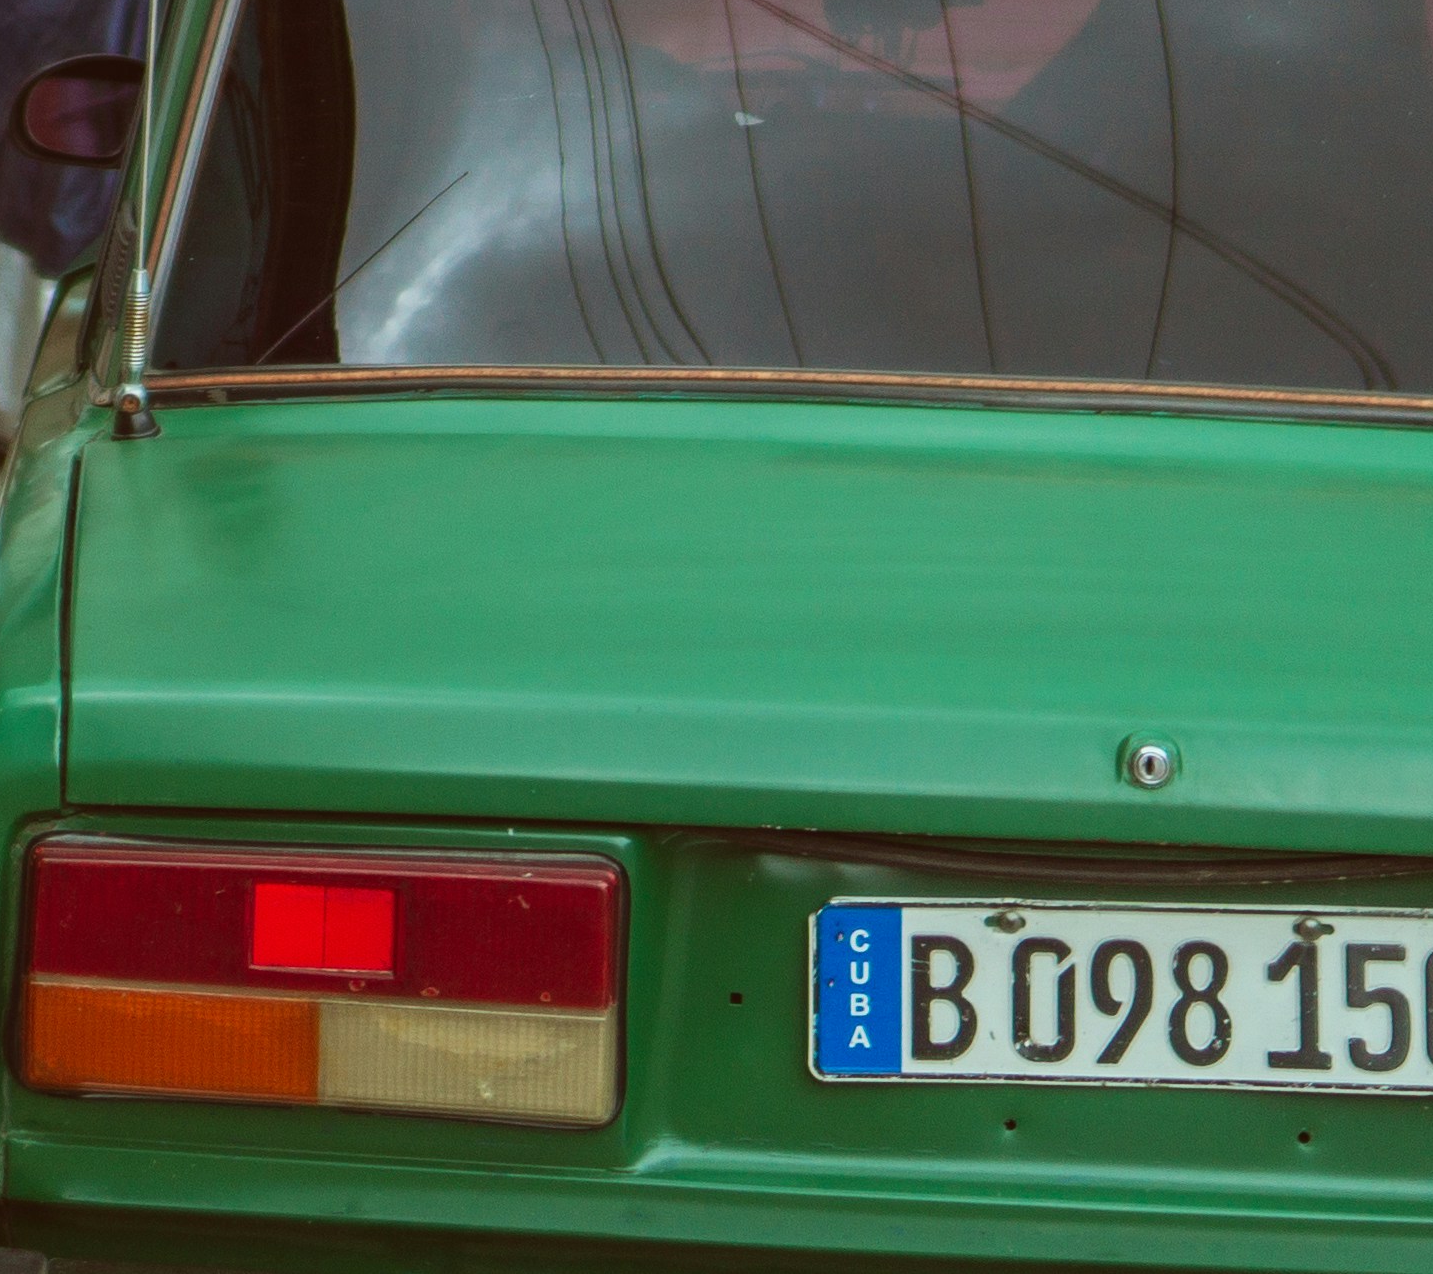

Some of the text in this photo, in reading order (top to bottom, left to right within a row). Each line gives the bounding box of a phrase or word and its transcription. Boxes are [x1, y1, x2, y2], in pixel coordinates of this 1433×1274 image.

[848, 928, 871, 1049] CUBA
[910, 933, 978, 1063] B
[1011, 937, 1231, 1067] 098
